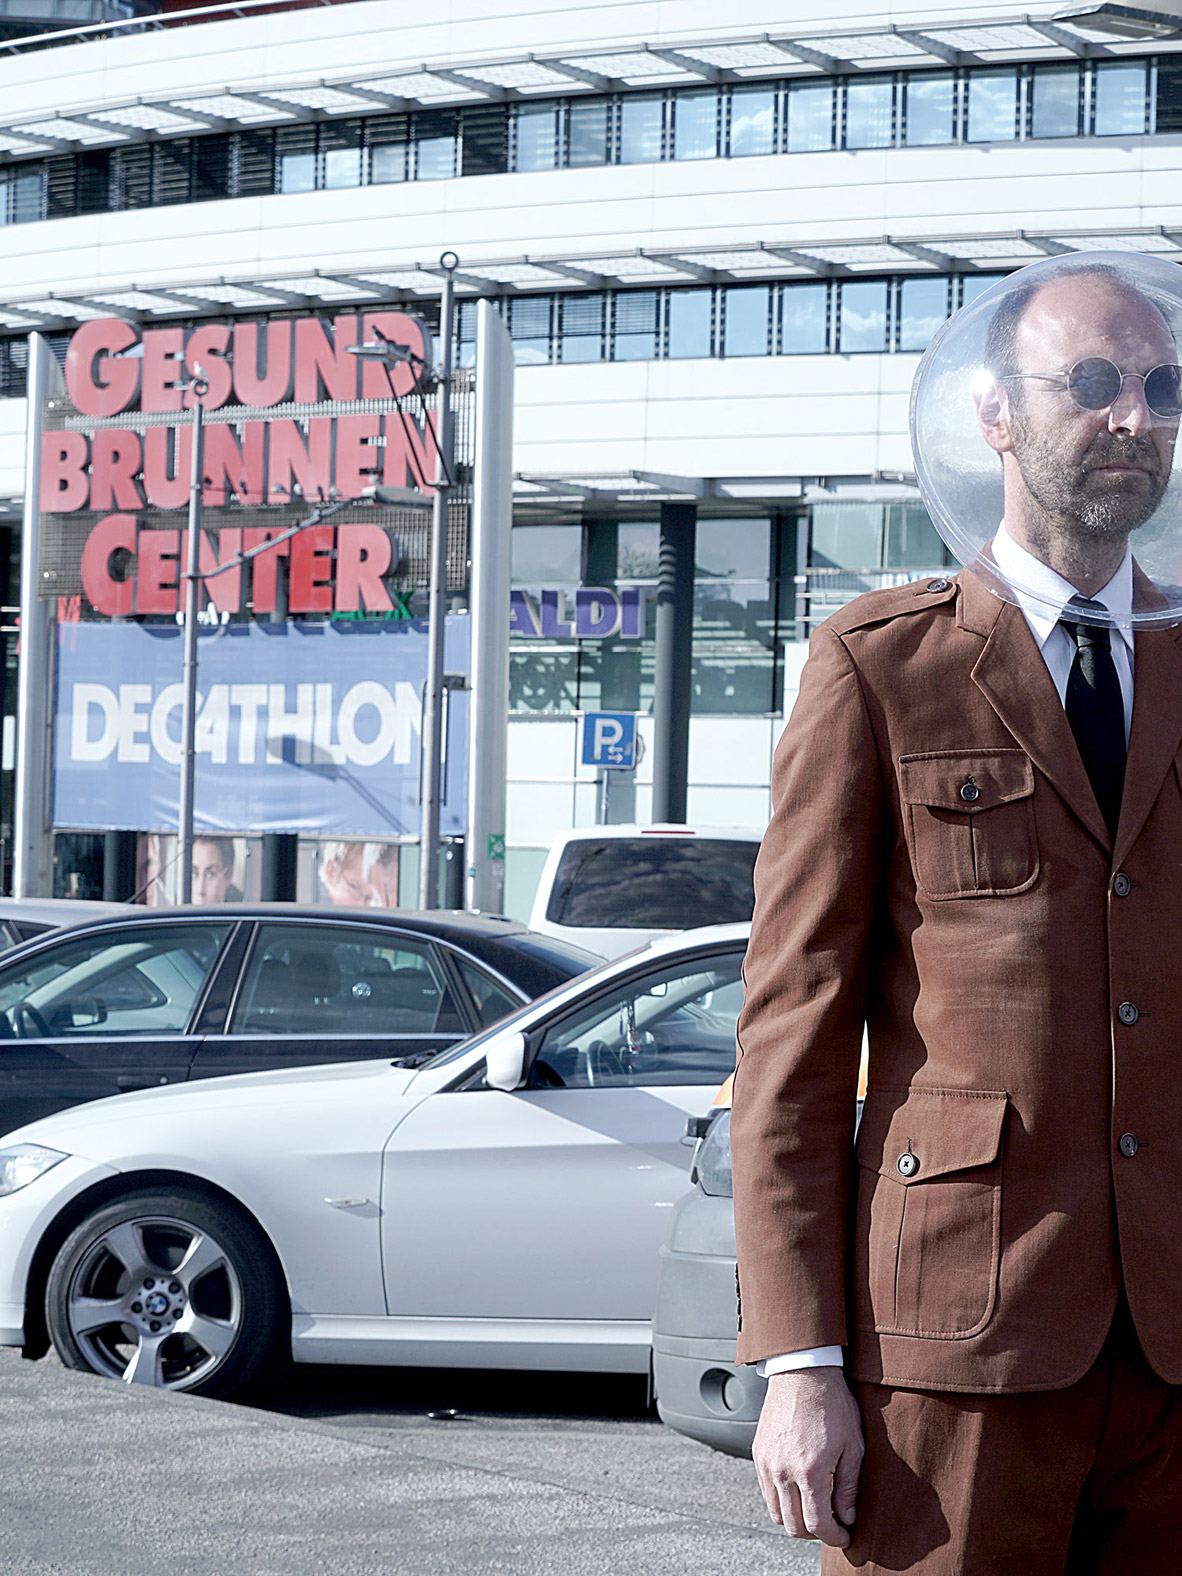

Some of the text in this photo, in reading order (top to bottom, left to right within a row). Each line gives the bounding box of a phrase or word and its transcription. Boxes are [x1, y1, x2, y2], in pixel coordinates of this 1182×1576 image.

[65, 312, 428, 418] GESUND
[40, 410, 438, 513] BRUNNEN
[82, 513, 395, 617] CENTER
[509, 588, 641, 638] ALDI
[71, 680, 447, 767] DECATHLON
[593, 718, 624, 760] P
